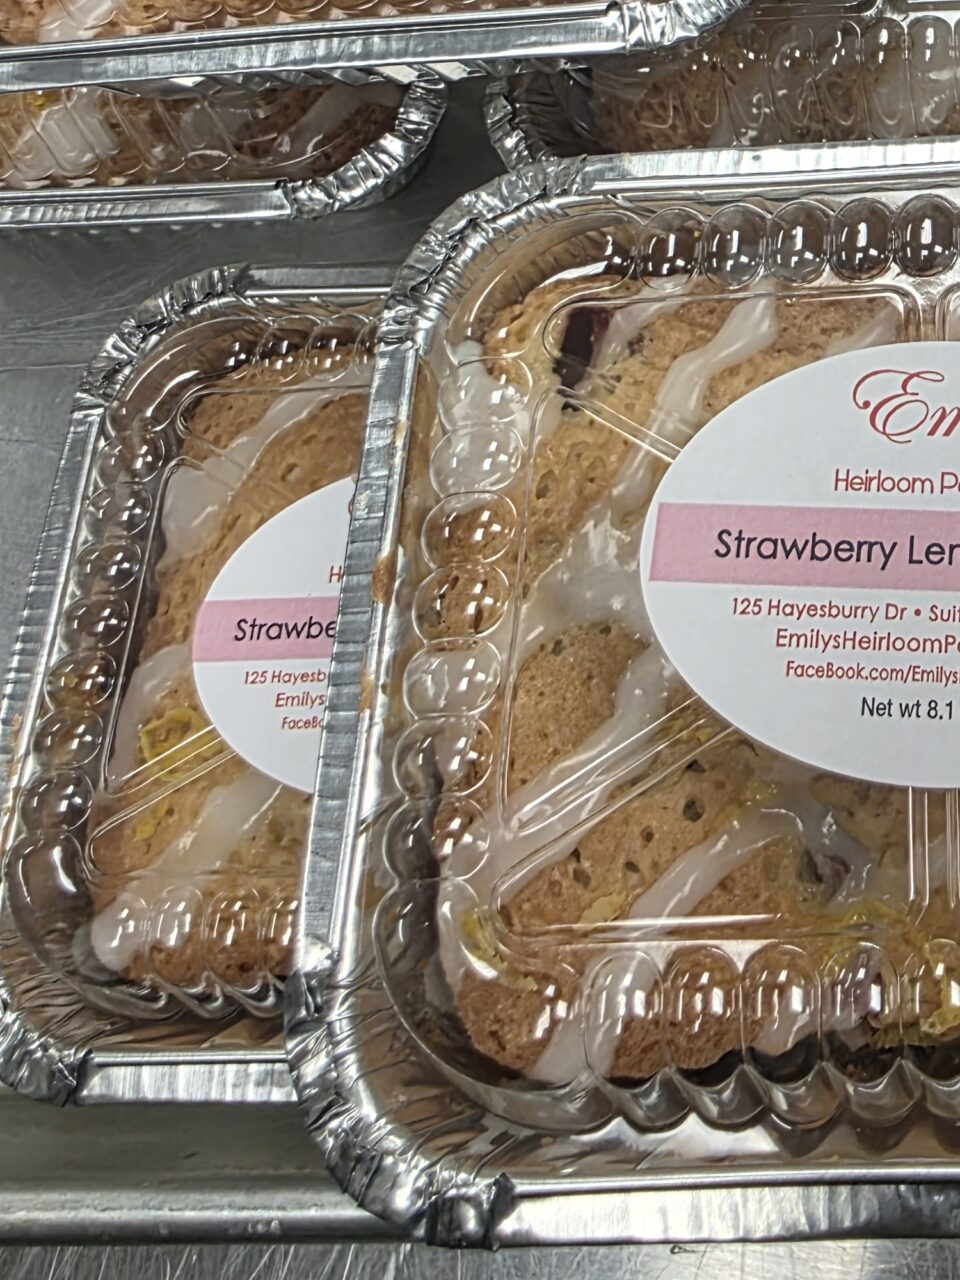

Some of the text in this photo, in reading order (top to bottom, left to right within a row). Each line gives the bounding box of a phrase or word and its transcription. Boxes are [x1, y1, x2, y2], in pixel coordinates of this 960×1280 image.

[834, 468, 934, 494] Heirloom
[714, 528, 898, 571] Strawberry
[732, 597, 763, 616] 125
[767, 598, 880, 623] Hayesburry
[885, 603, 908, 621] Dr
[234, 616, 337, 642] Strawbe
[244, 668, 327, 685] 125 Hayesb
[861, 696, 893, 718] Net
[899, 701, 921, 719] wt
[927, 699, 954, 721] 8.1
